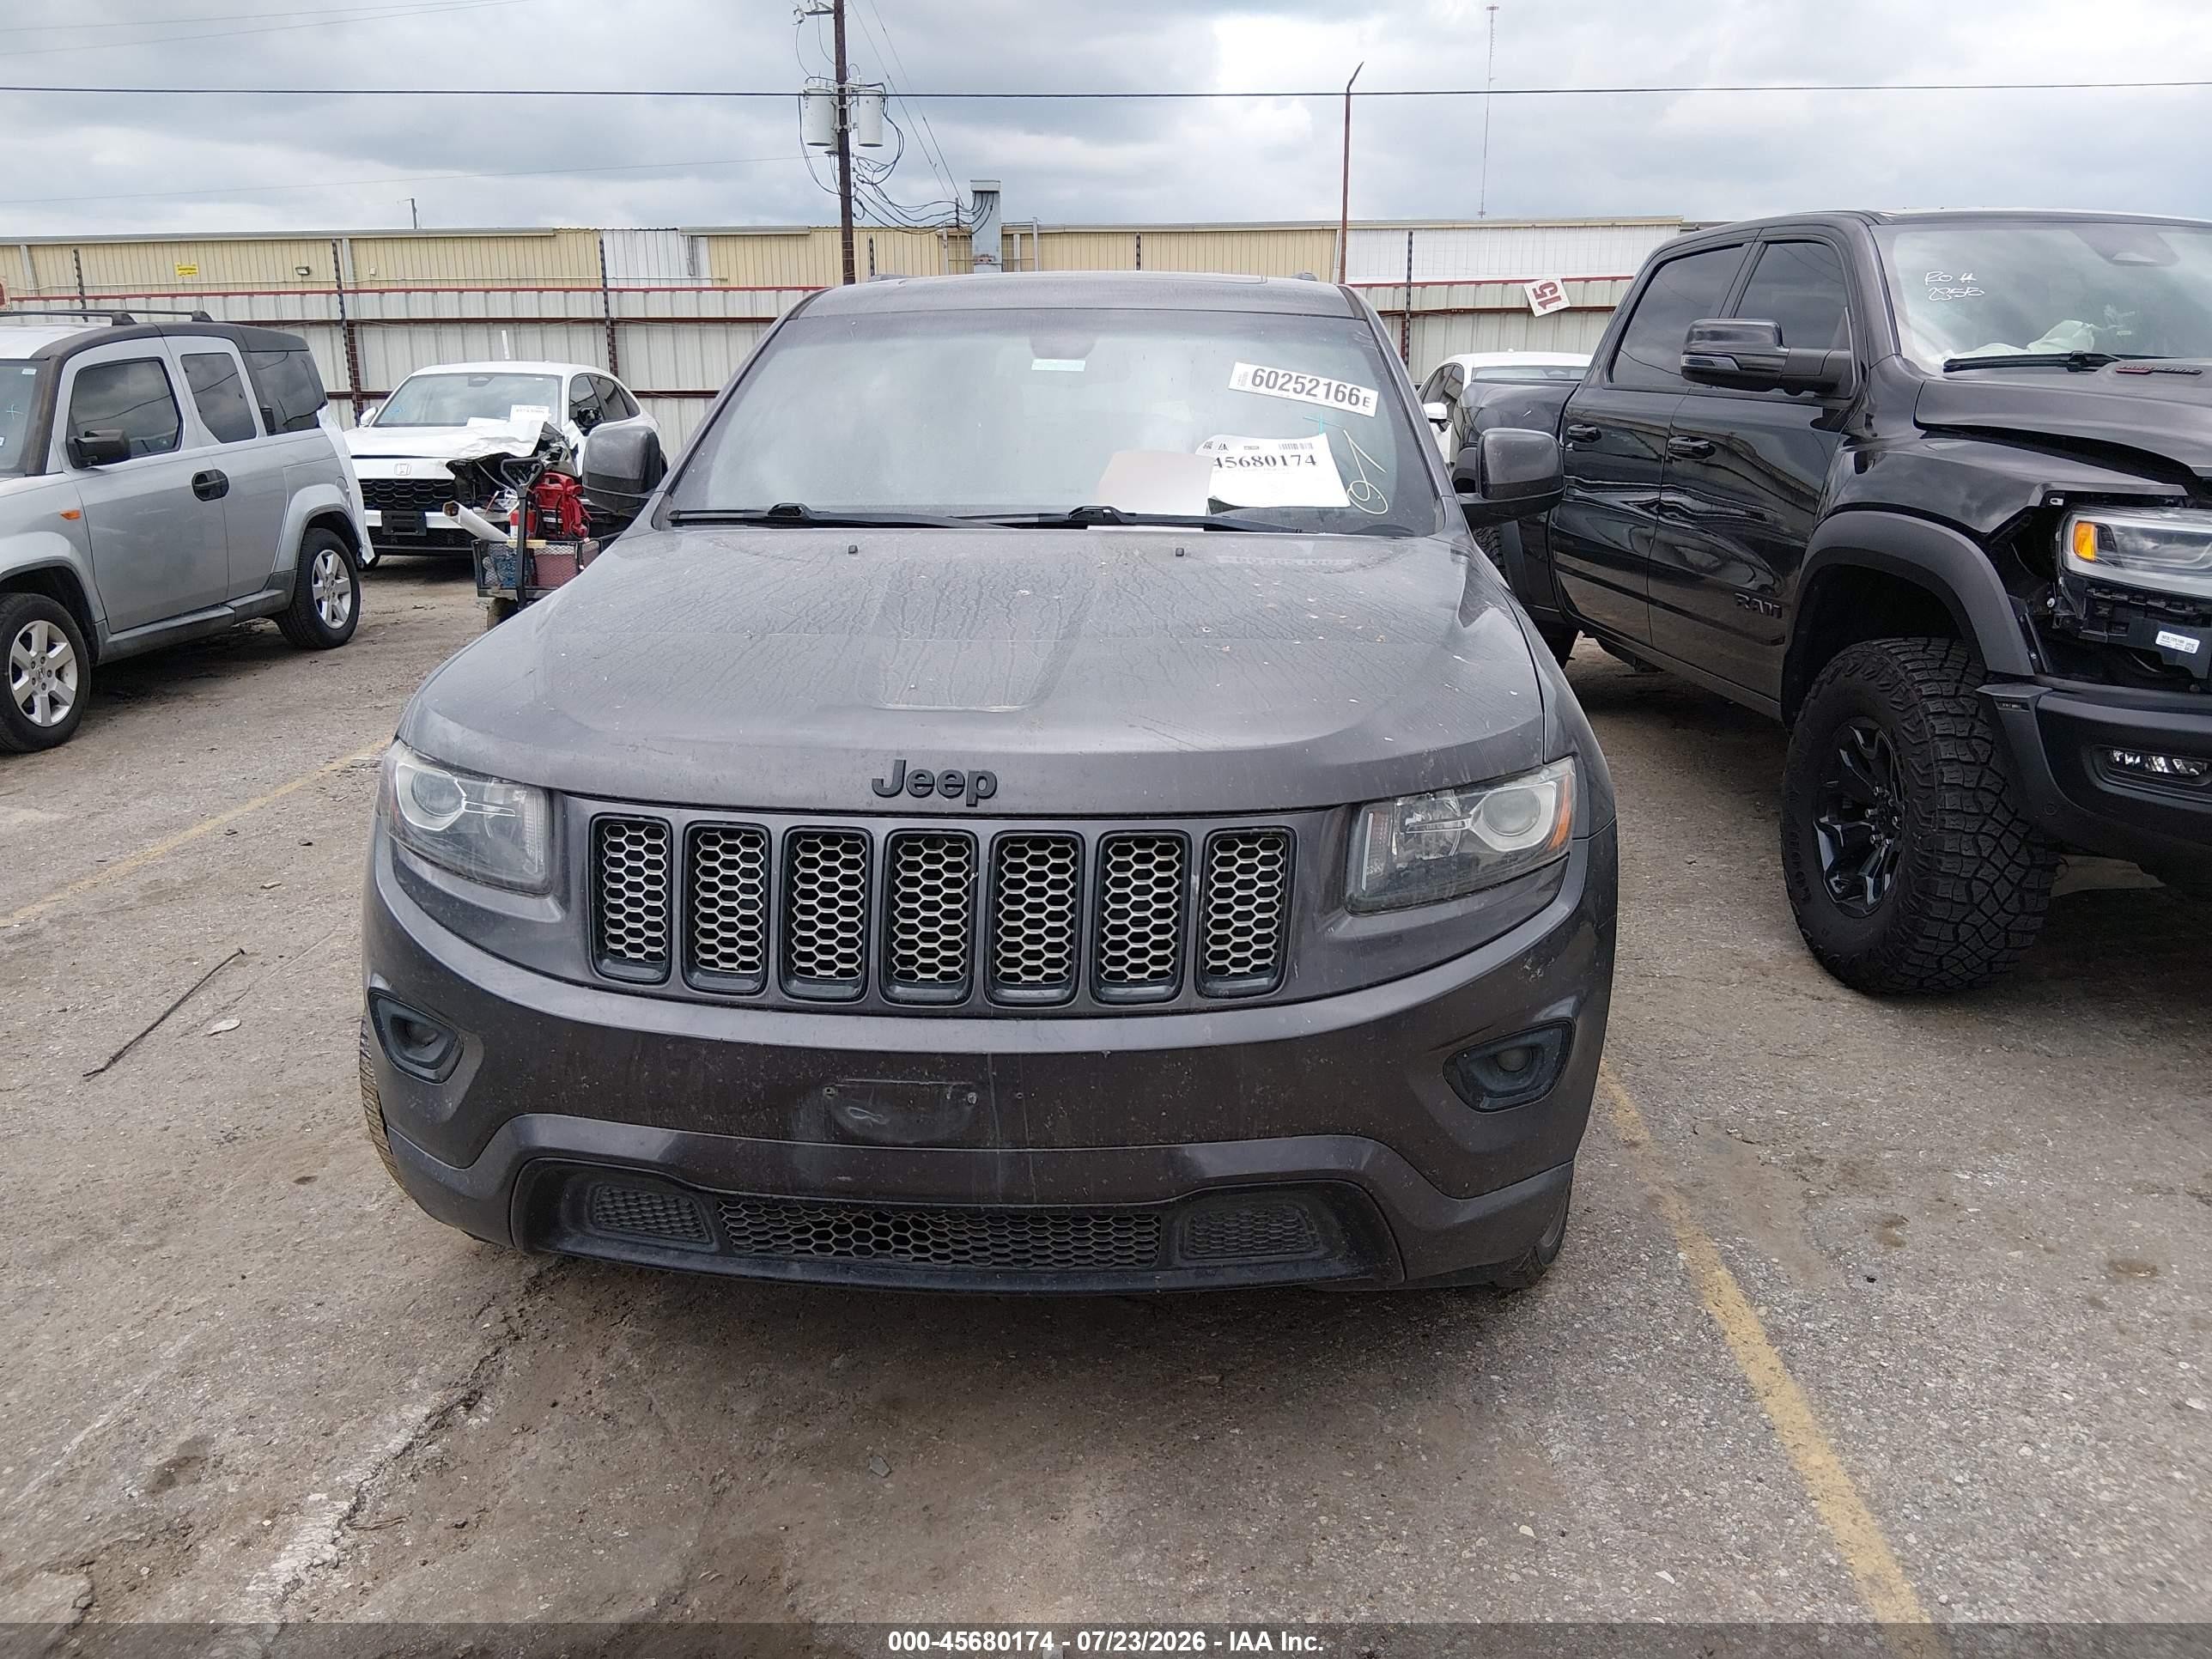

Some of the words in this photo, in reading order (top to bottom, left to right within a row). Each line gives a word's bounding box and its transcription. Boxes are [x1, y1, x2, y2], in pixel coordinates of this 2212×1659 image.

[1532, 282, 1562, 310] 15
[1251, 368, 1361, 406] 60252166
[1362, 396, 1371, 408] E
[1213, 453, 1317, 469] 45680174
[872, 759, 998, 807] Jeep
